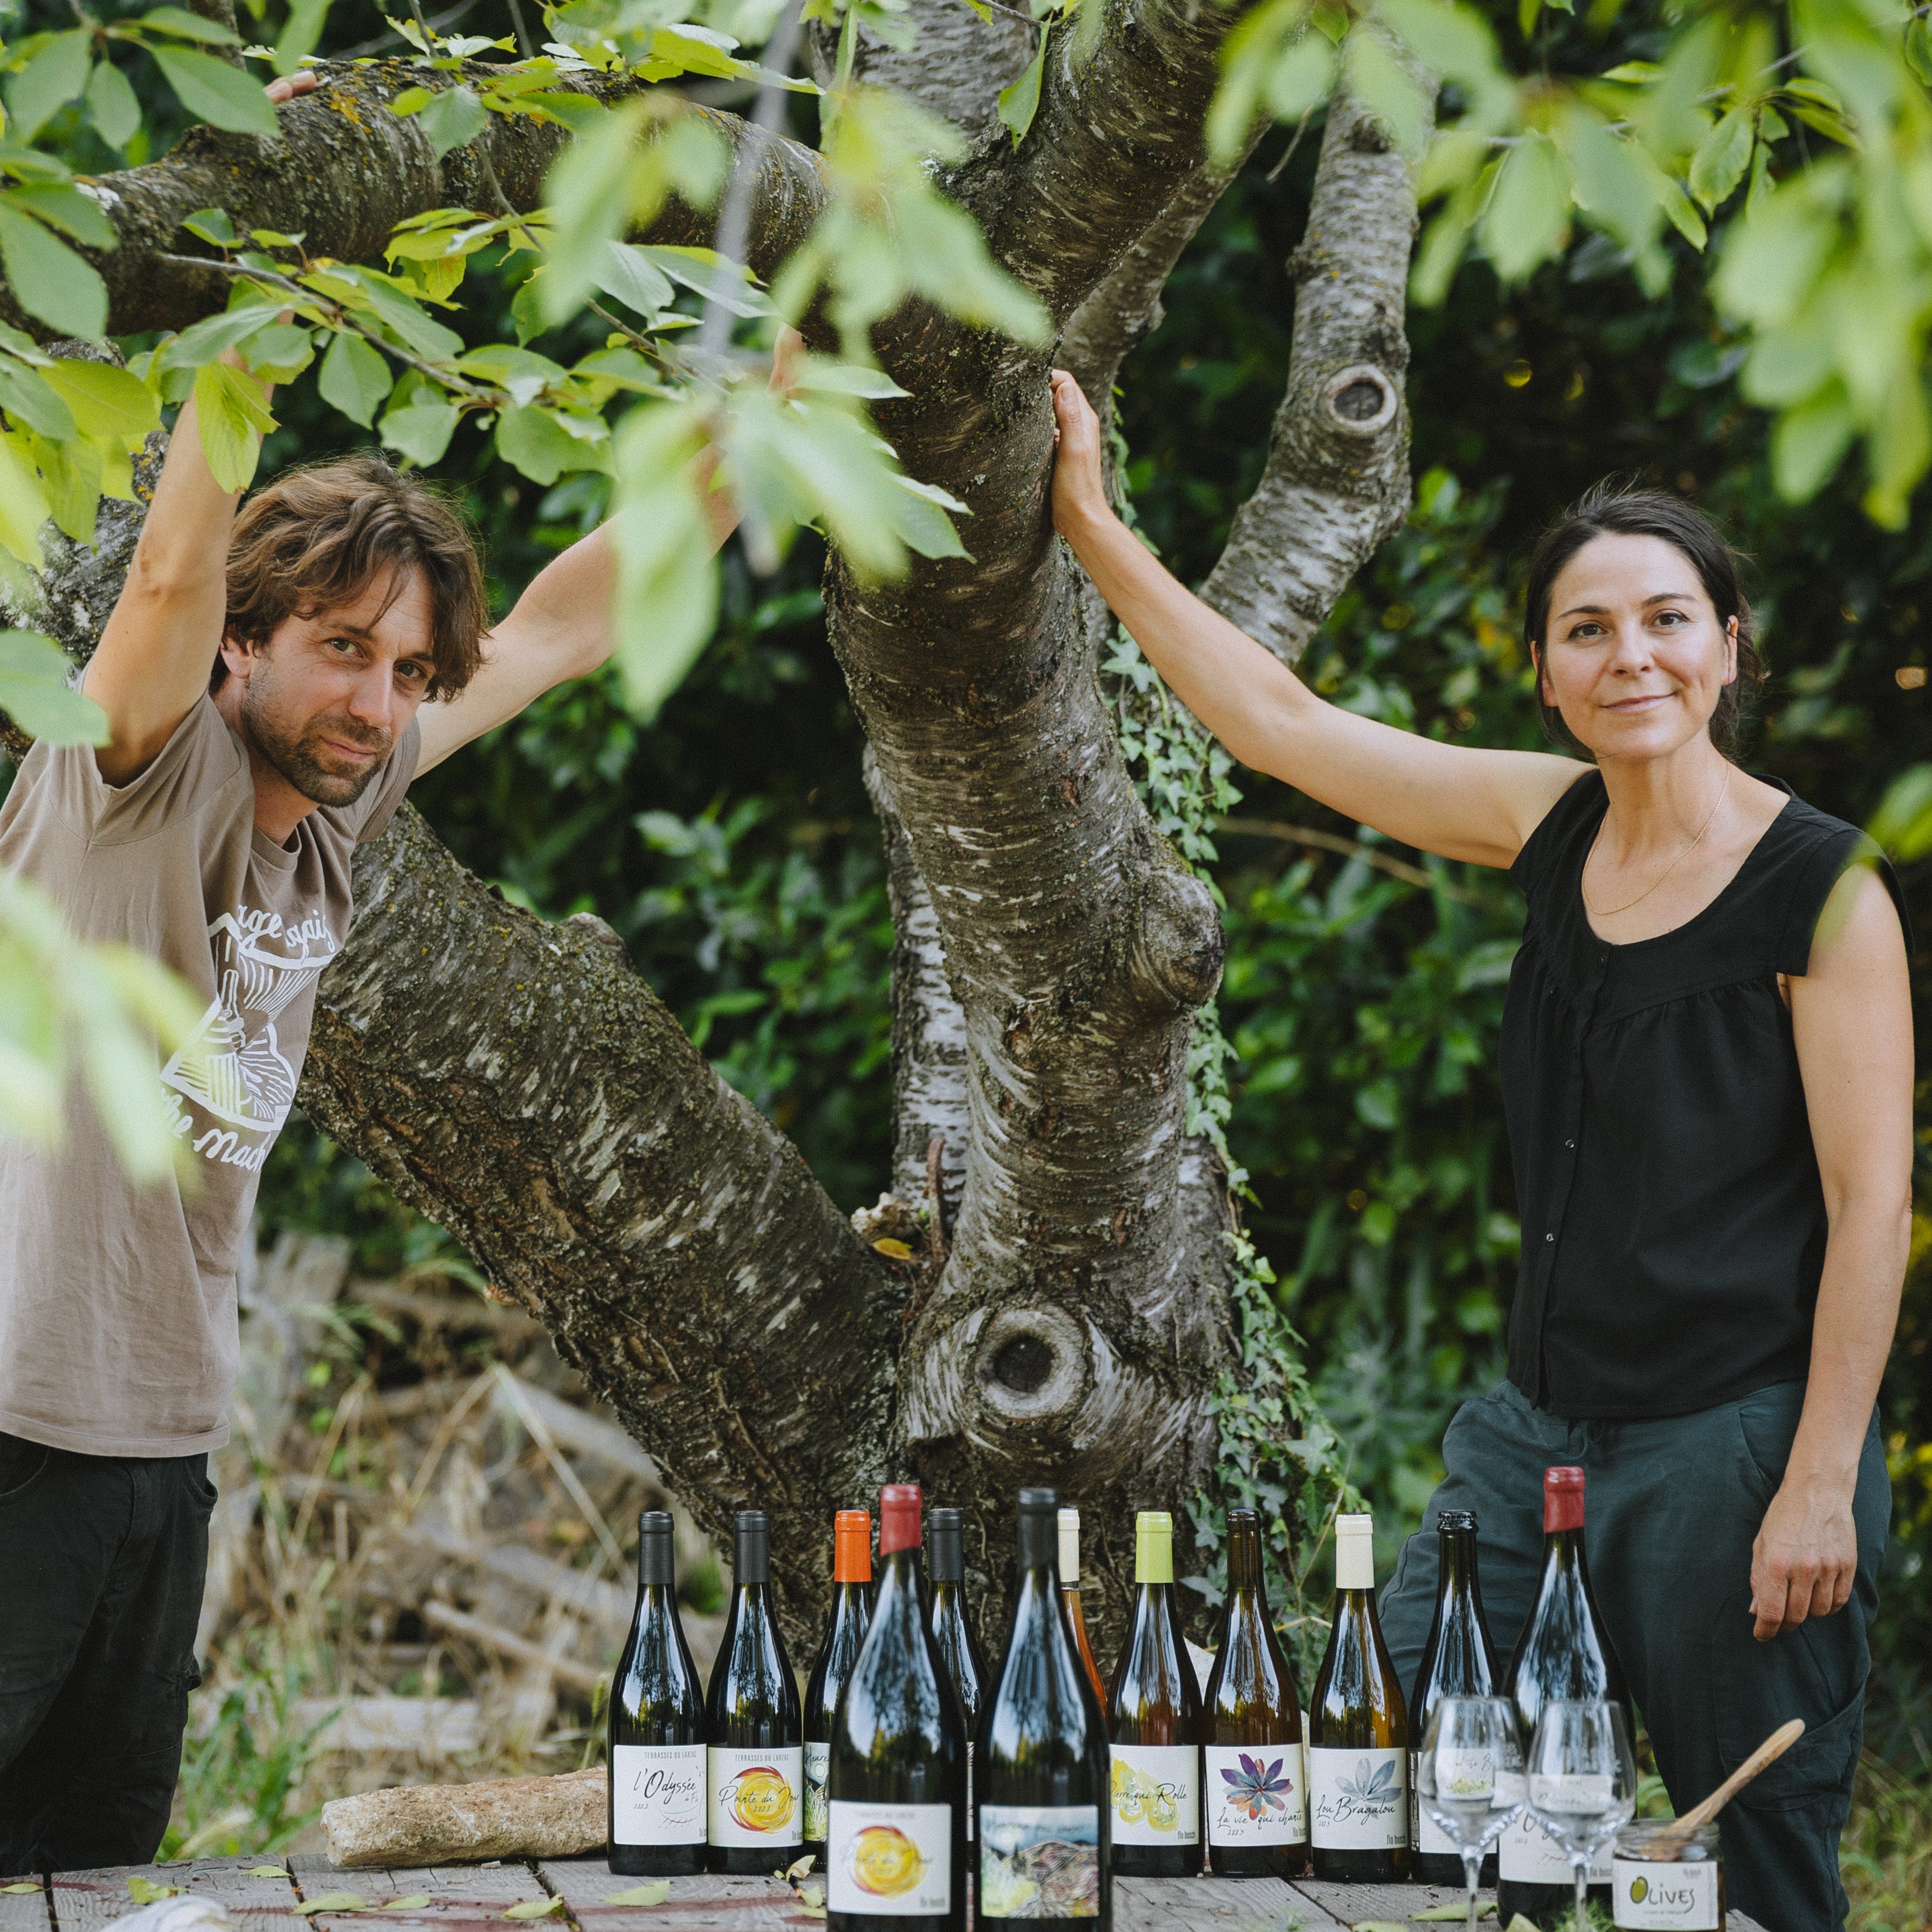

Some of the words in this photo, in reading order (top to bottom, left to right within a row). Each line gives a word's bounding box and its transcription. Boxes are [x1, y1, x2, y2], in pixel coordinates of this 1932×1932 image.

[805, 1745, 829, 1768] Heure
[633, 1768, 696, 1805] l'Odyssée
[719, 1785, 758, 1807] Pointe
[761, 1789, 774, 1803] du
[1134, 1792, 1151, 1806] qui
[1156, 1783, 1188, 1806] Rolle
[1217, 1806, 1232, 1829] La
[1234, 1816, 1248, 1824] vie
[1258, 1814, 1275, 1830] qui
[1279, 1807, 1303, 1826] chante
[1316, 1795, 1334, 1819] Lou
[1334, 1796, 1396, 1825] Bragalou
